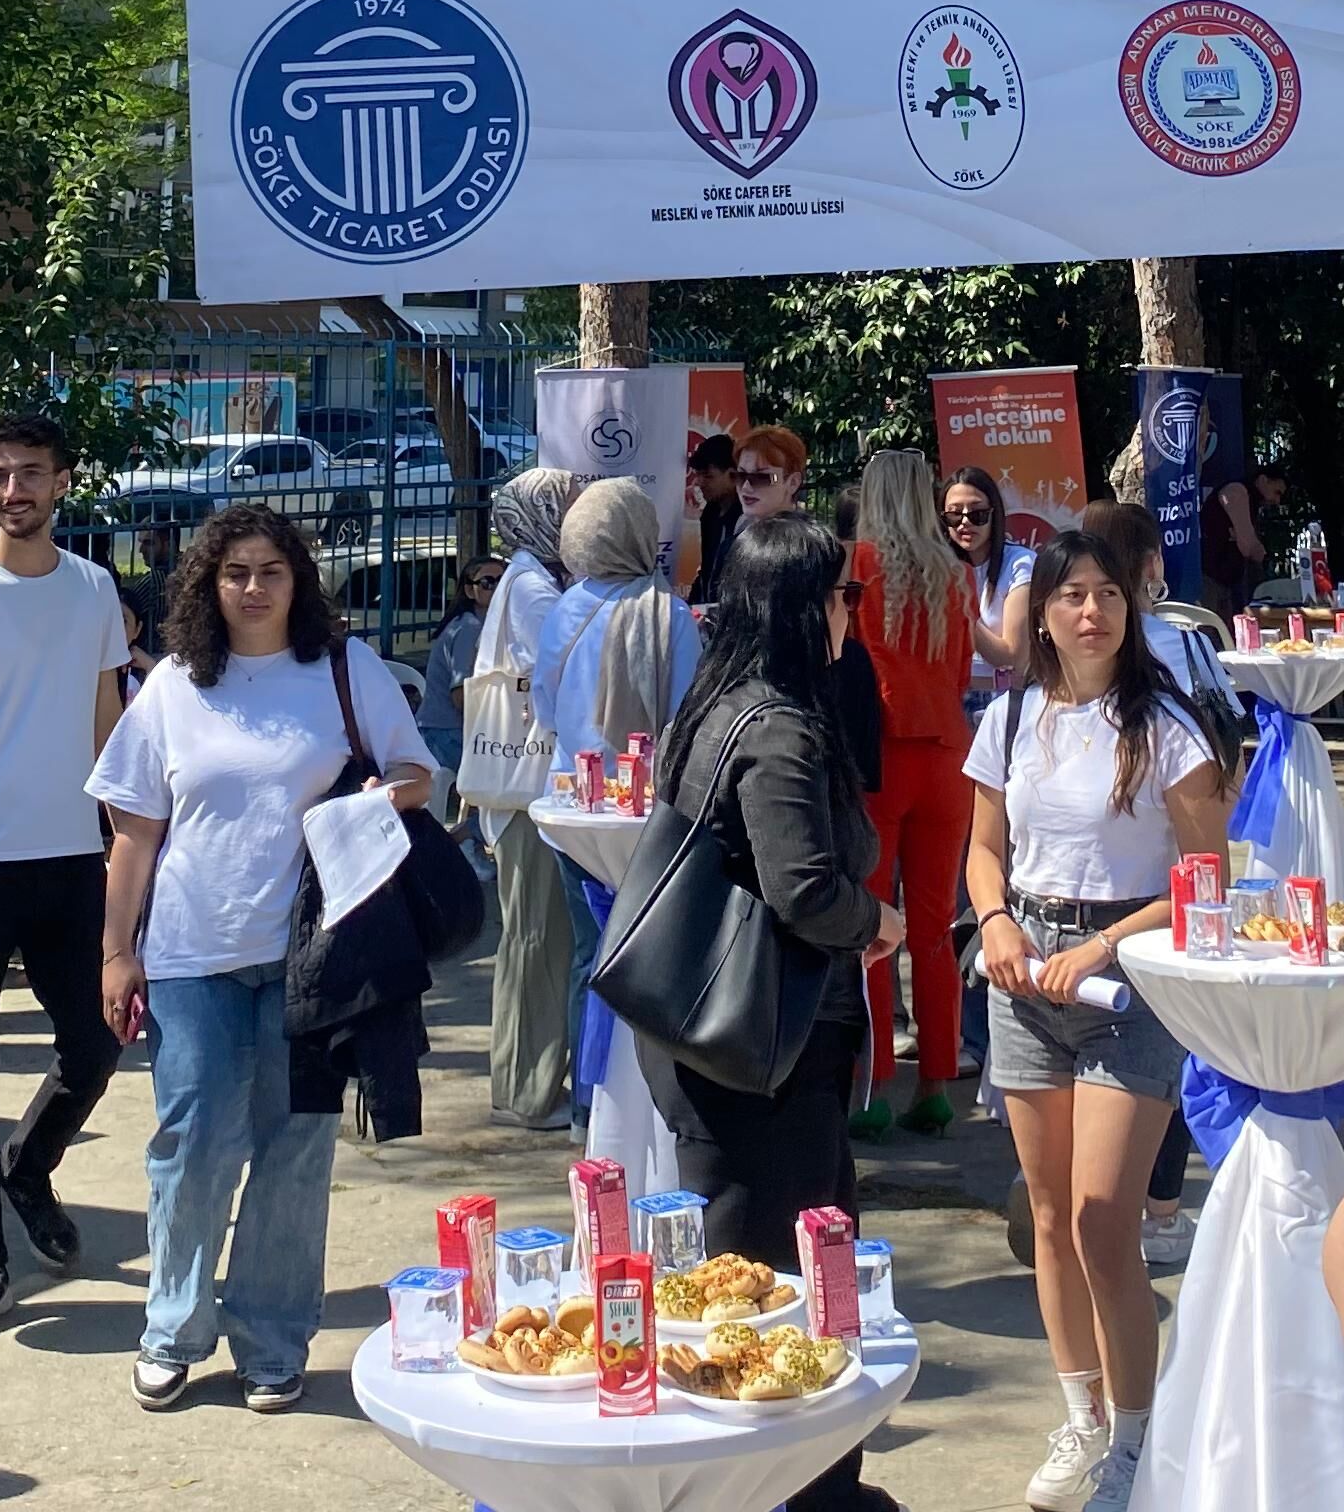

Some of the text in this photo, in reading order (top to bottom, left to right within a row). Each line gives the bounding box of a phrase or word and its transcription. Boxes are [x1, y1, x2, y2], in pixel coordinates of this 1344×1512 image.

[925, 11, 959, 35] TEKNİK
[962, 15, 1005, 59] ANADOLU
[1127, 5, 1283, 63] ADNAN MENDERES
[951, 109, 977, 119] 1969
[1196, 121, 1235, 133] SÖKE
[1153, 134, 1172, 155] VE
[1234, 117, 1289, 168] ANADOLU
[1202, 137, 1233, 149] 1981
[250, 117, 512, 247] SÖKE TİCARET ODASI
[952, 169, 985, 183] SÖKE
[703, 185, 792, 201] SÖKE CAFER EFE
[651, 197, 844, 222] MESLEKİ ve TEKNİK ANADOLU LİSESİ
[949, 404, 1066, 435] geleceğine
[984, 426, 1052, 447] dokun
